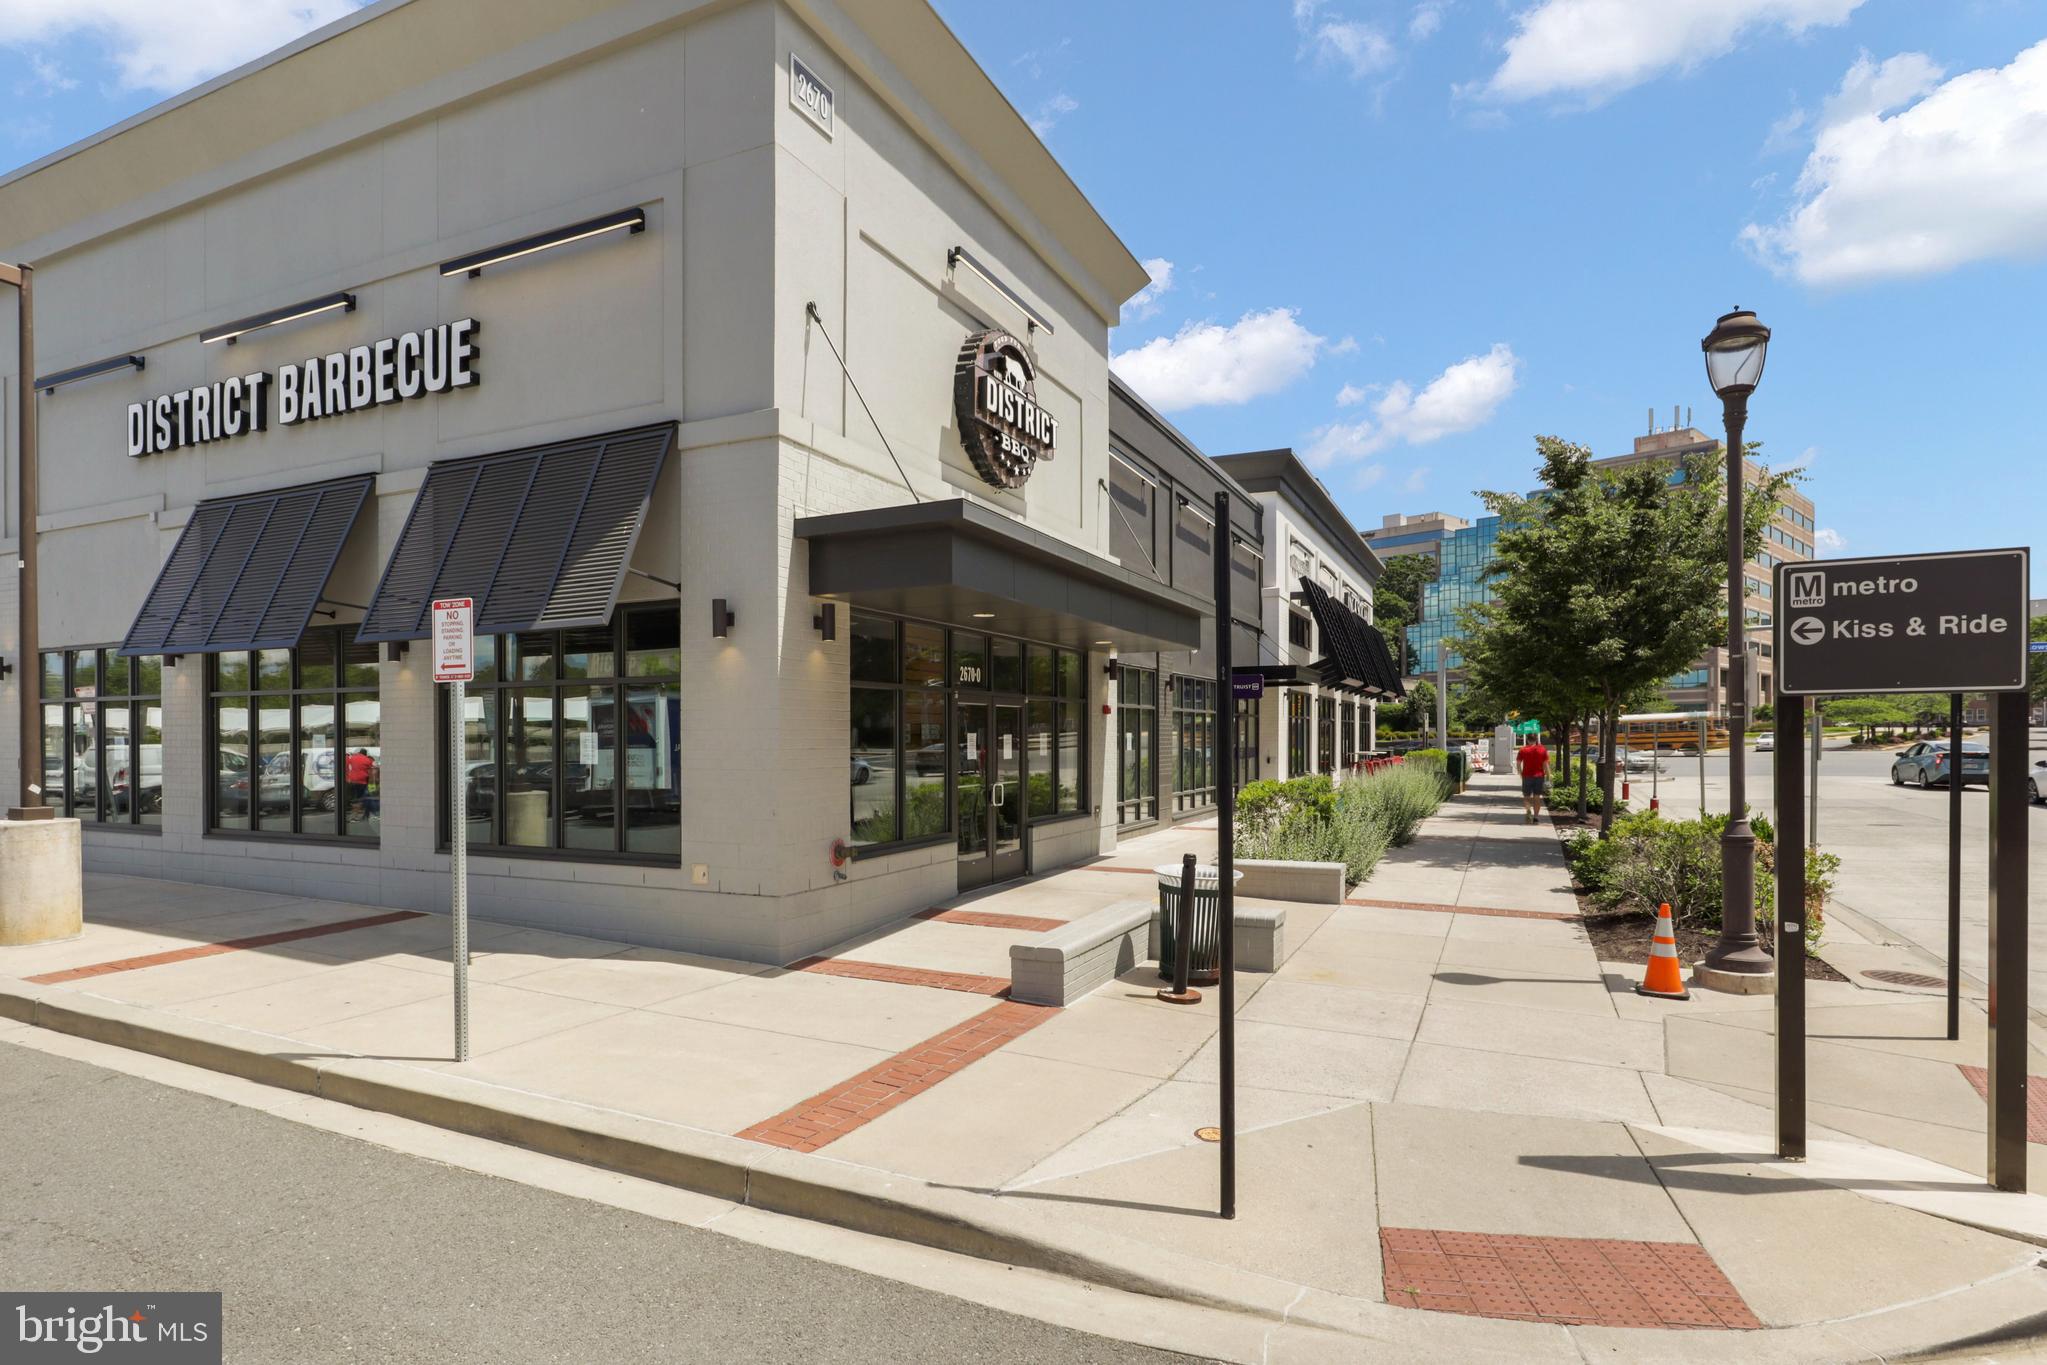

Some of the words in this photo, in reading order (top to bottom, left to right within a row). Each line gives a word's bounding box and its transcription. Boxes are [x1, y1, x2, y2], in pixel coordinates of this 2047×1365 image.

[798, 74, 828, 120] 2670
[127, 372, 270, 458] DISTRICT
[278, 318, 478, 426] BARBECUE
[986, 375, 1059, 449] DISTRICT
[1001, 432, 1030, 464] BBQ
[1794, 574, 1822, 598] M
[1833, 576, 1918, 597] metro
[1792, 597, 1824, 607] metro
[446, 610, 459, 620] NO
[1832, 619, 1895, 639] Kiss
[1905, 616, 1927, 637] &
[1939, 614, 2008, 635] Ride
